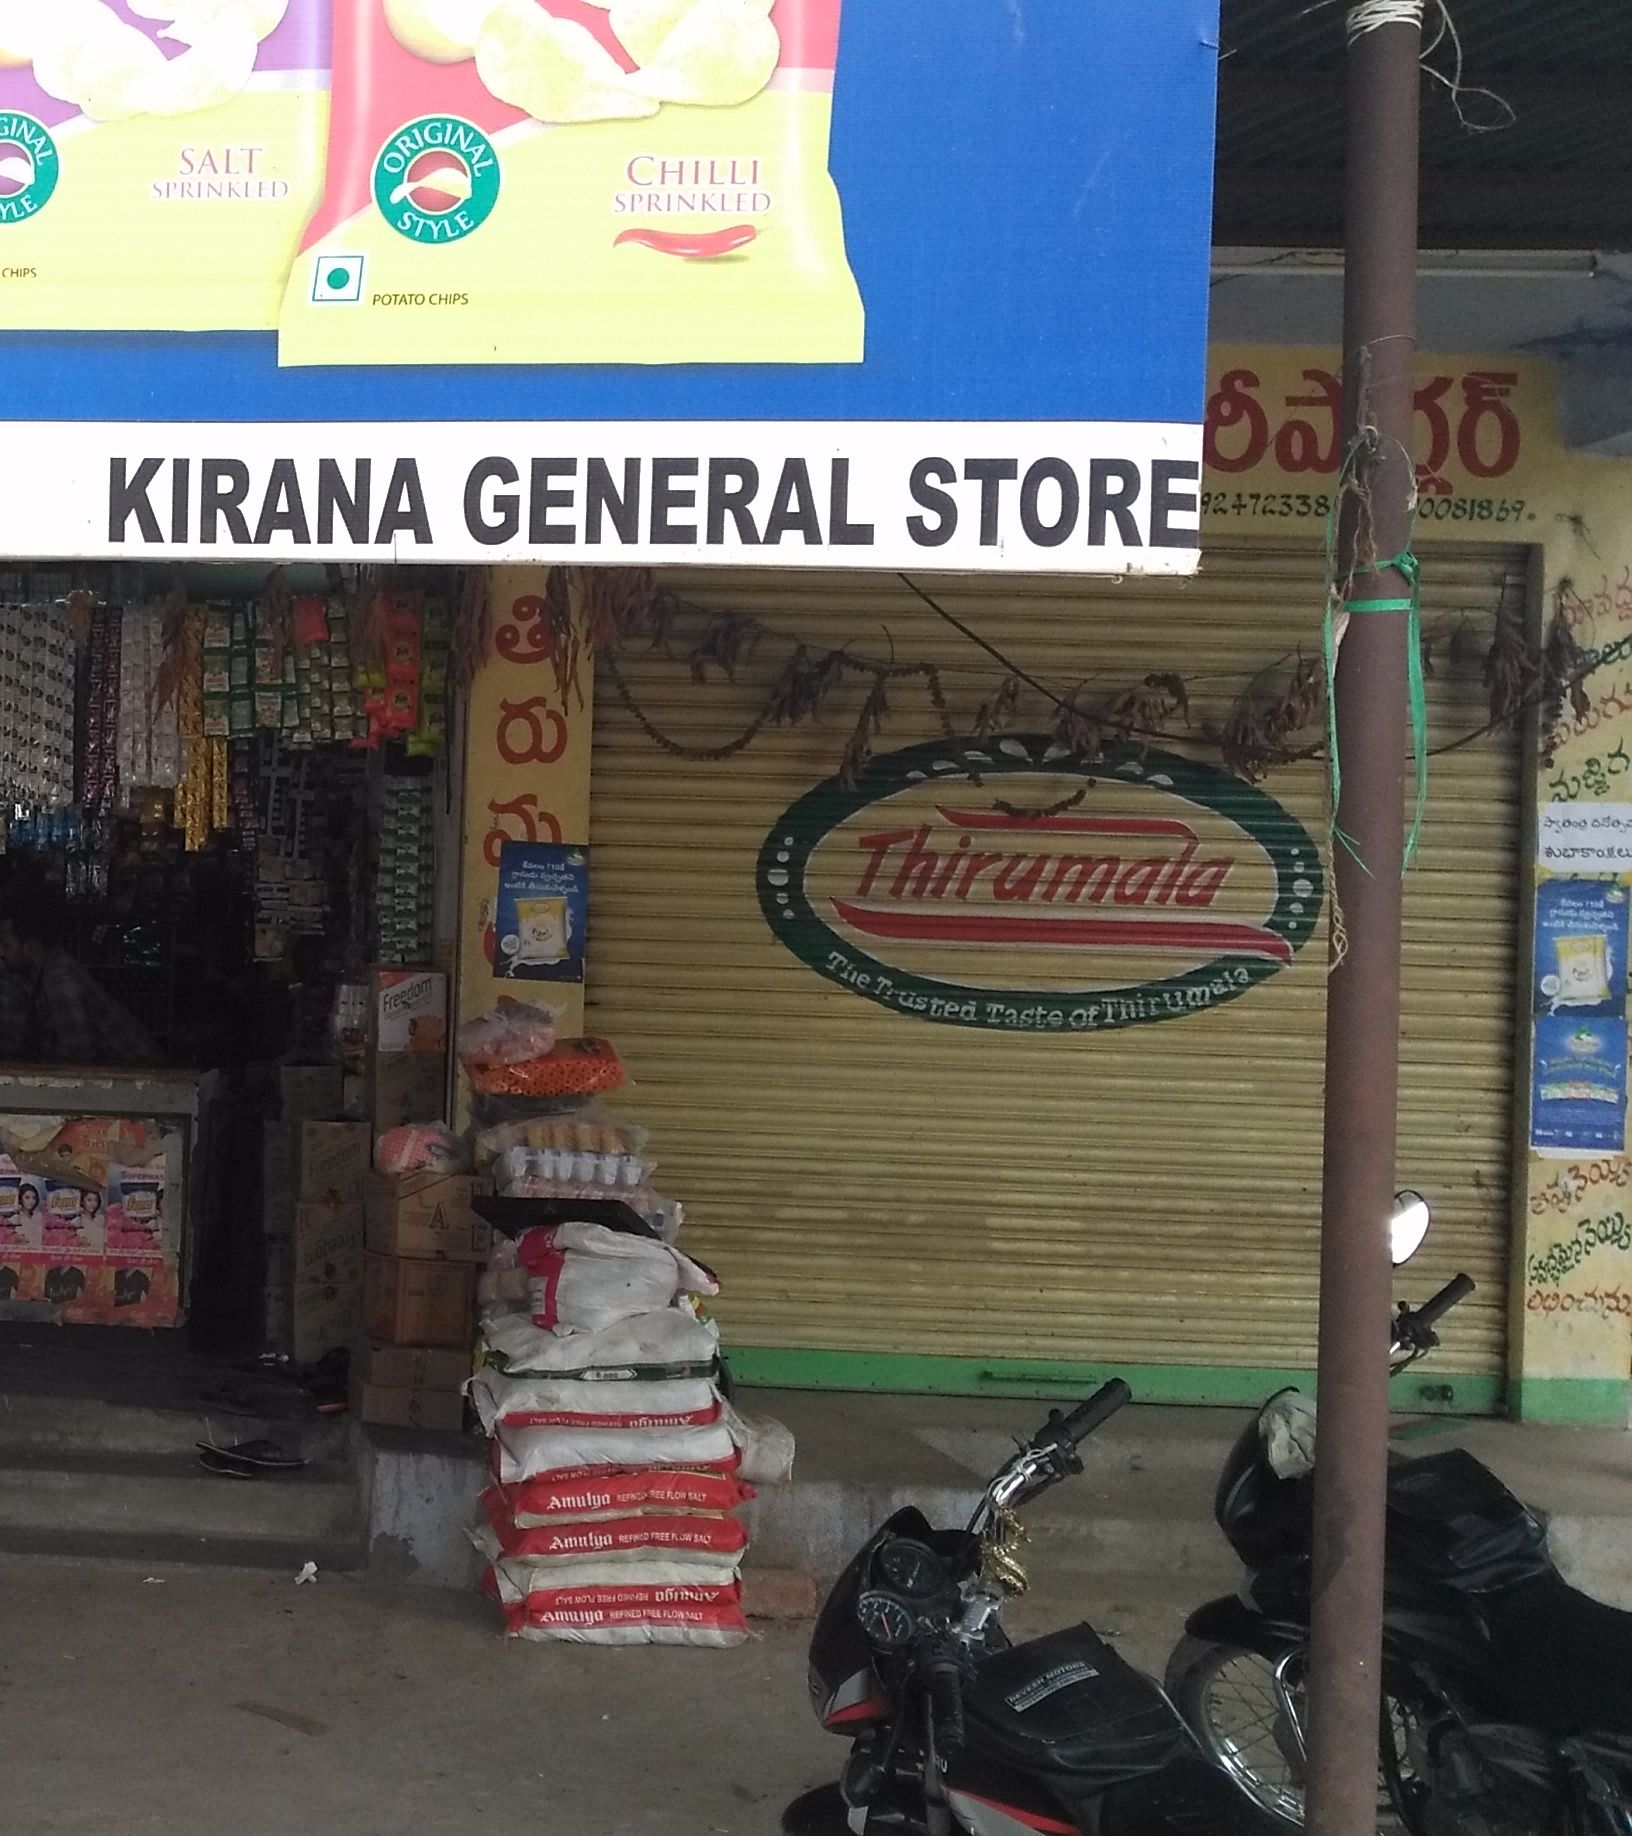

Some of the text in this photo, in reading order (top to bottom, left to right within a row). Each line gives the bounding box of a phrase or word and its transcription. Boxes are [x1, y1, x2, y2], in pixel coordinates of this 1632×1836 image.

[179, 148, 263, 176] SALT
[382, 121, 495, 178] ORIGINAL
[627, 156, 760, 187] CHILLI
[152, 180, 289, 200] SPRINKLED
[614, 192, 771, 213] SPRINKLED
[397, 209, 476, 241] STYLE
[2, 266, 38, 279] CHIPS
[372, 292, 469, 307] POTATO CHIPS
[108, 456, 1200, 549] KIRANA GENERAL STORE
[856, 824, 1235, 908] Thirumala
[384, 978, 432, 1012] Freedom
[825, 950, 1251, 1029] The Trusted Taste of Thirumala
[547, 1491, 611, 1510] Amulya
[667, 1491, 687, 1501] FLOW
[688, 1493, 706, 1502] SALT
[549, 1532, 613, 1550] Amulya
[651, 1532, 669, 1542] FREE
[693, 1533, 711, 1543] SALT
[540, 1609, 604, 1627] Amulya
[643, 1609, 661, 1618] FREE
